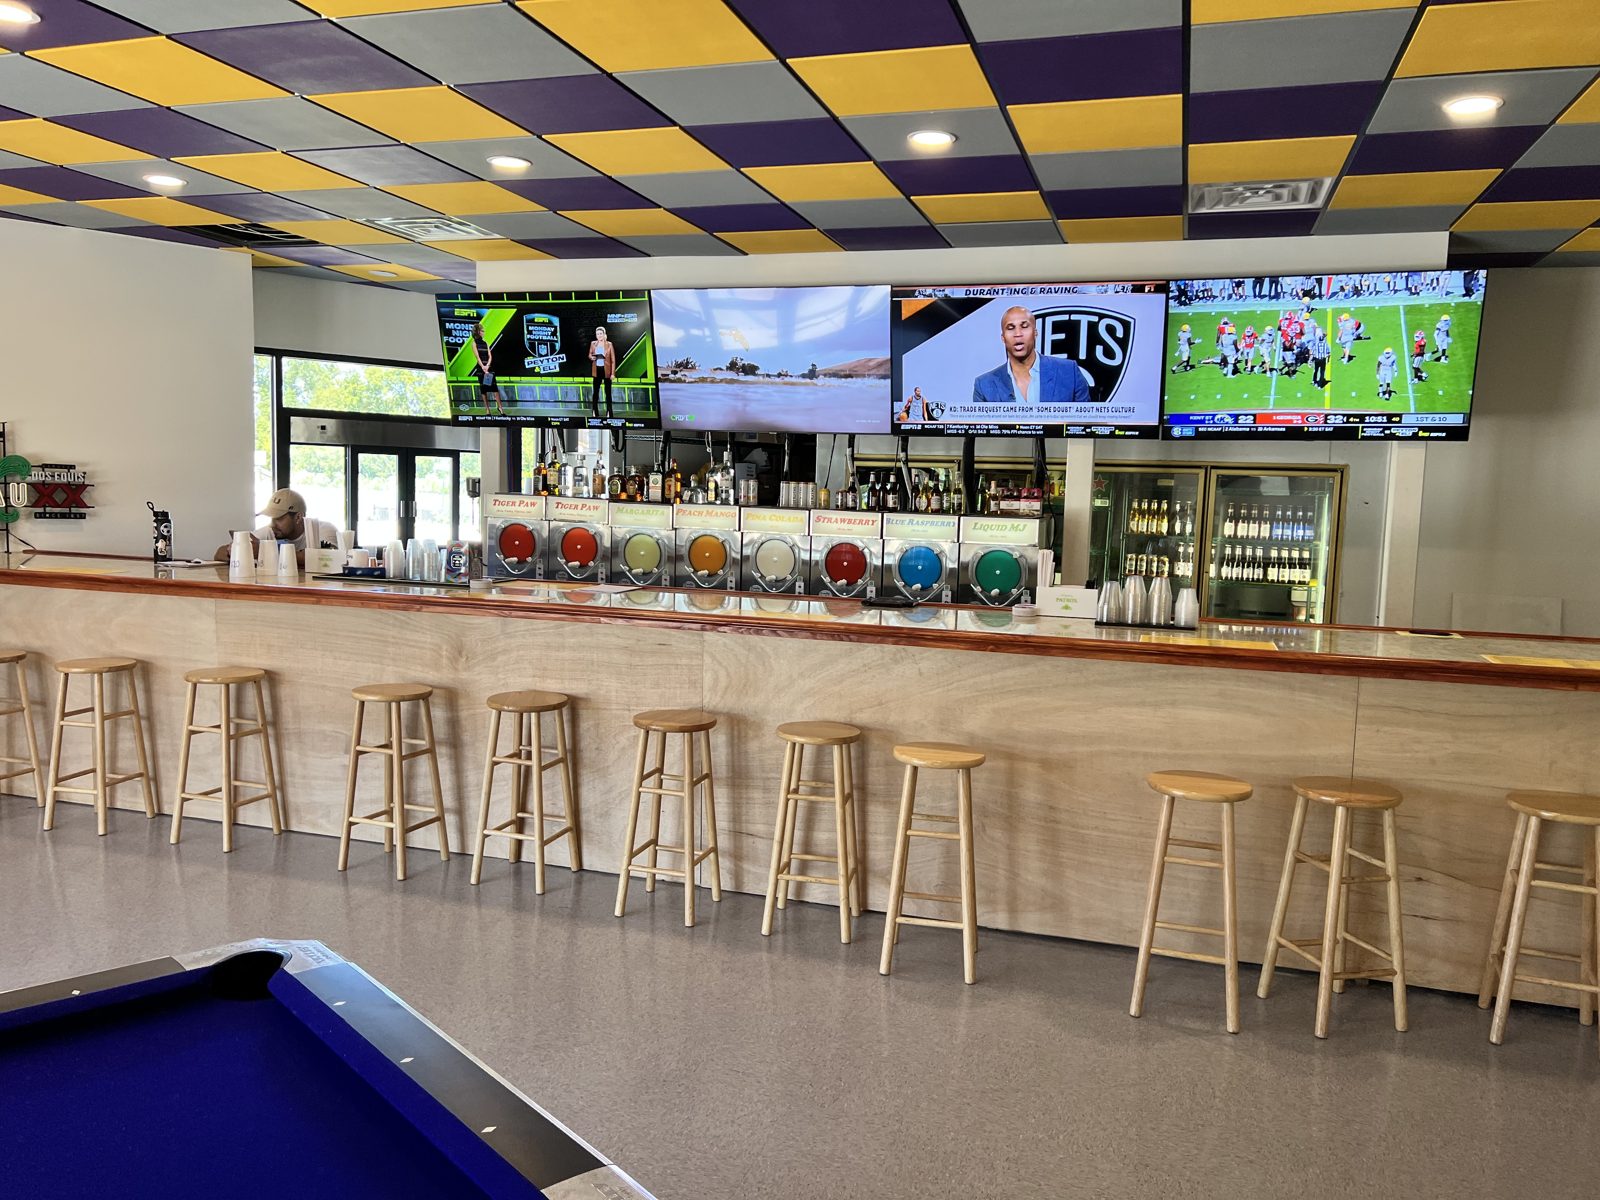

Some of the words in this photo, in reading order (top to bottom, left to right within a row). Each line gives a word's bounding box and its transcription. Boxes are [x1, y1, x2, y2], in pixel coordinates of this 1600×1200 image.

[1039, 286, 1079, 295] RAVING
[454, 308, 477, 317] ESPN
[445, 322, 474, 330] MOND
[443, 336, 467, 344] FOOT
[527, 355, 565, 367] PEYTON
[1238, 415, 1254, 424] 22
[1326, 415, 1344, 424] 32
[31, 471, 52, 481] DOS
[54, 471, 85, 482] EQUIS
[30, 483, 89, 509] XX
[492, 499, 516, 507] TIGER
[518, 499, 538, 508] PAW
[555, 502, 580, 510] TIGER
[580, 503, 600, 511] PAW
[615, 506, 665, 516] MARGARITA
[675, 508, 703, 517] PEACH
[704, 509, 737, 518] MANGO
[768, 512, 804, 524] COLADA
[815, 515, 878, 527] STRAWBERRY
[886, 517, 905, 526] BLUE
[905, 518, 956, 528] RASPBERRY
[972, 521, 1007, 533] LIQUID
[1008, 523, 1028, 533] MJ
